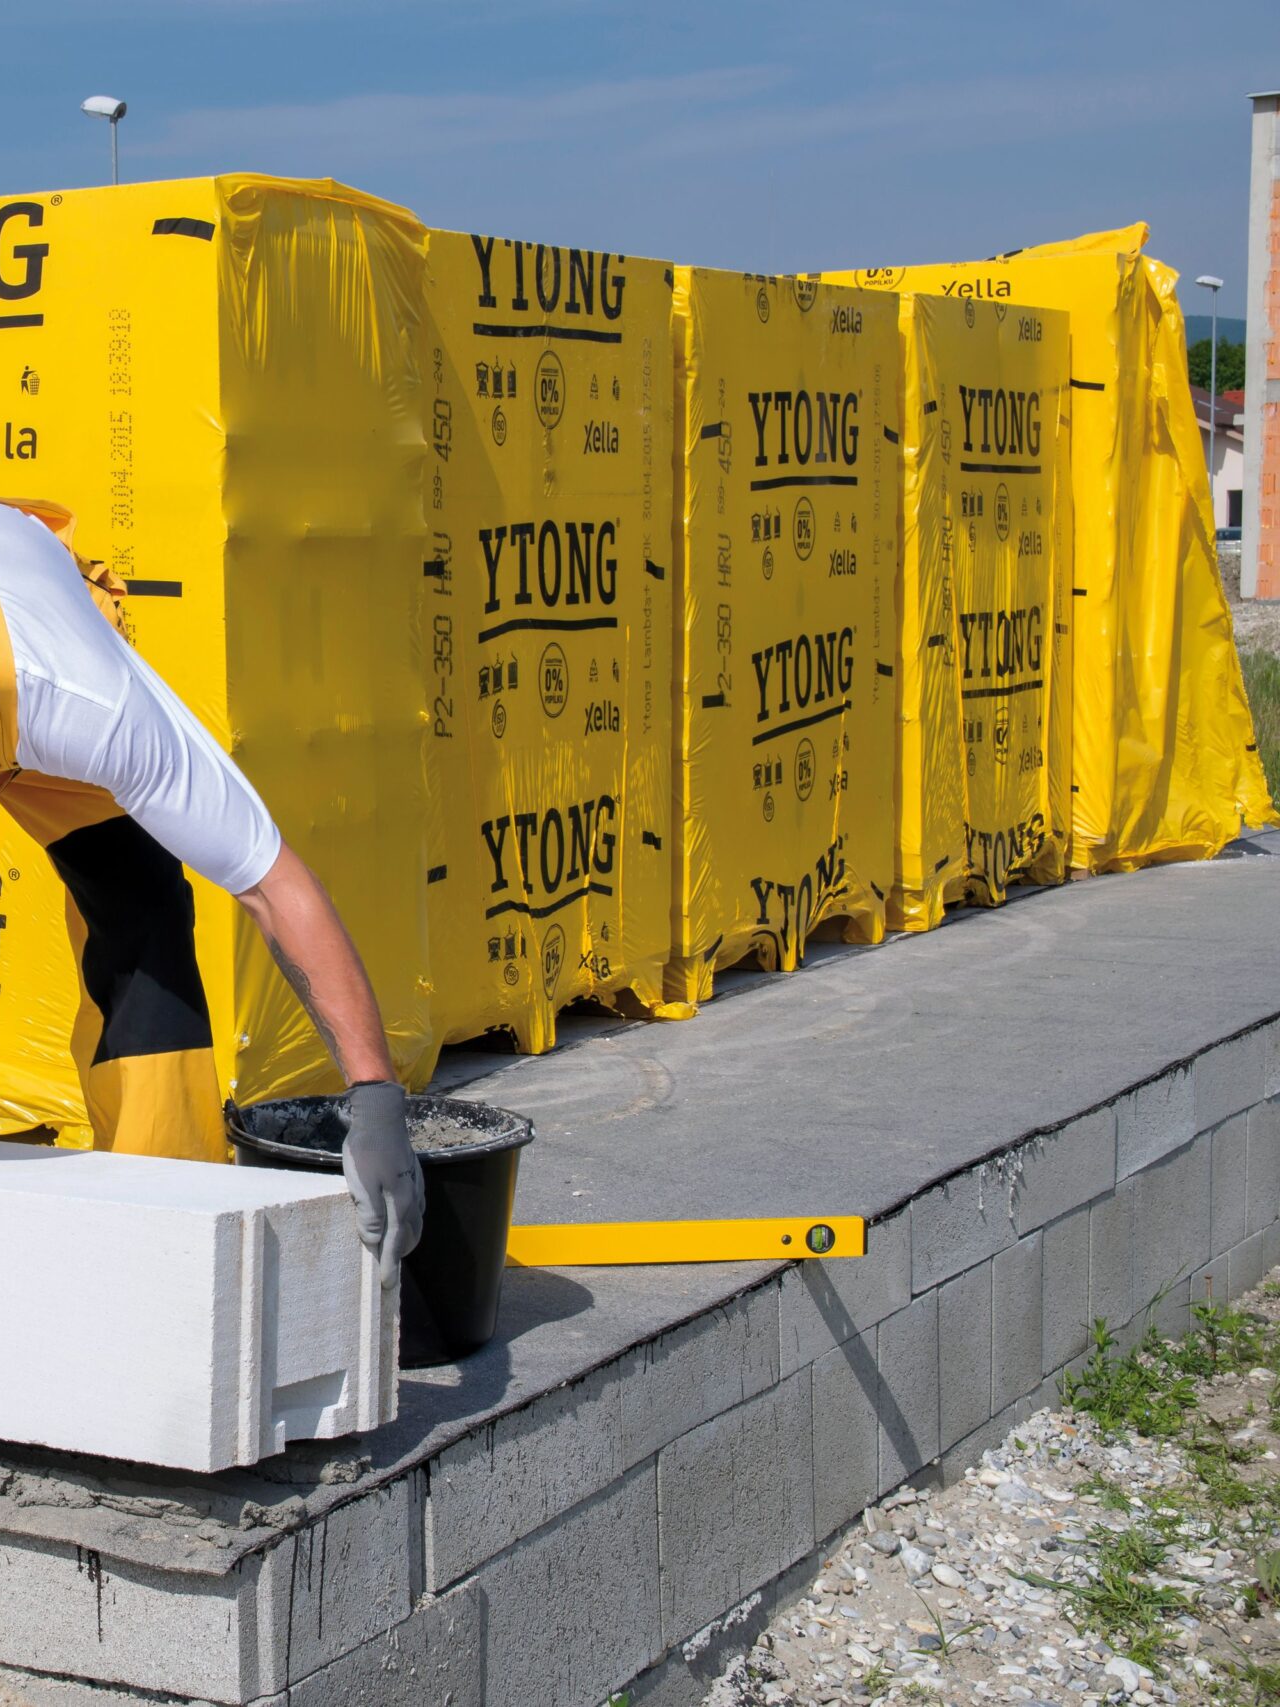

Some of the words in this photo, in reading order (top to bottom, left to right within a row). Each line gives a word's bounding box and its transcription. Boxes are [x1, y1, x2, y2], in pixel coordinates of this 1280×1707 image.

[470, 234, 626, 321] YTONG
[941, 278, 1011, 299] Xella
[831, 304, 862, 336] Xella
[1018, 316, 1043, 343] Xella
[108, 308, 132, 396] 18:39:18
[540, 377, 559, 404] 0%
[583, 419, 619, 455] Xella
[748, 389, 860, 467] YTONG
[959, 384, 1042, 457] YTONG
[109, 410, 134, 530] 30.04.2015
[797, 519, 811, 540] 0%
[1018, 530, 1043, 559] Xella
[478, 520, 618, 614] YTONG
[828, 548, 857, 578] Xella
[959, 605, 1042, 680] YTONG
[432, 613, 453, 739] P2-350
[544, 667, 563, 692] 0%
[751, 626, 854, 724] YTONG
[584, 699, 620, 737] Xella
[481, 794, 616, 895] YTONG
